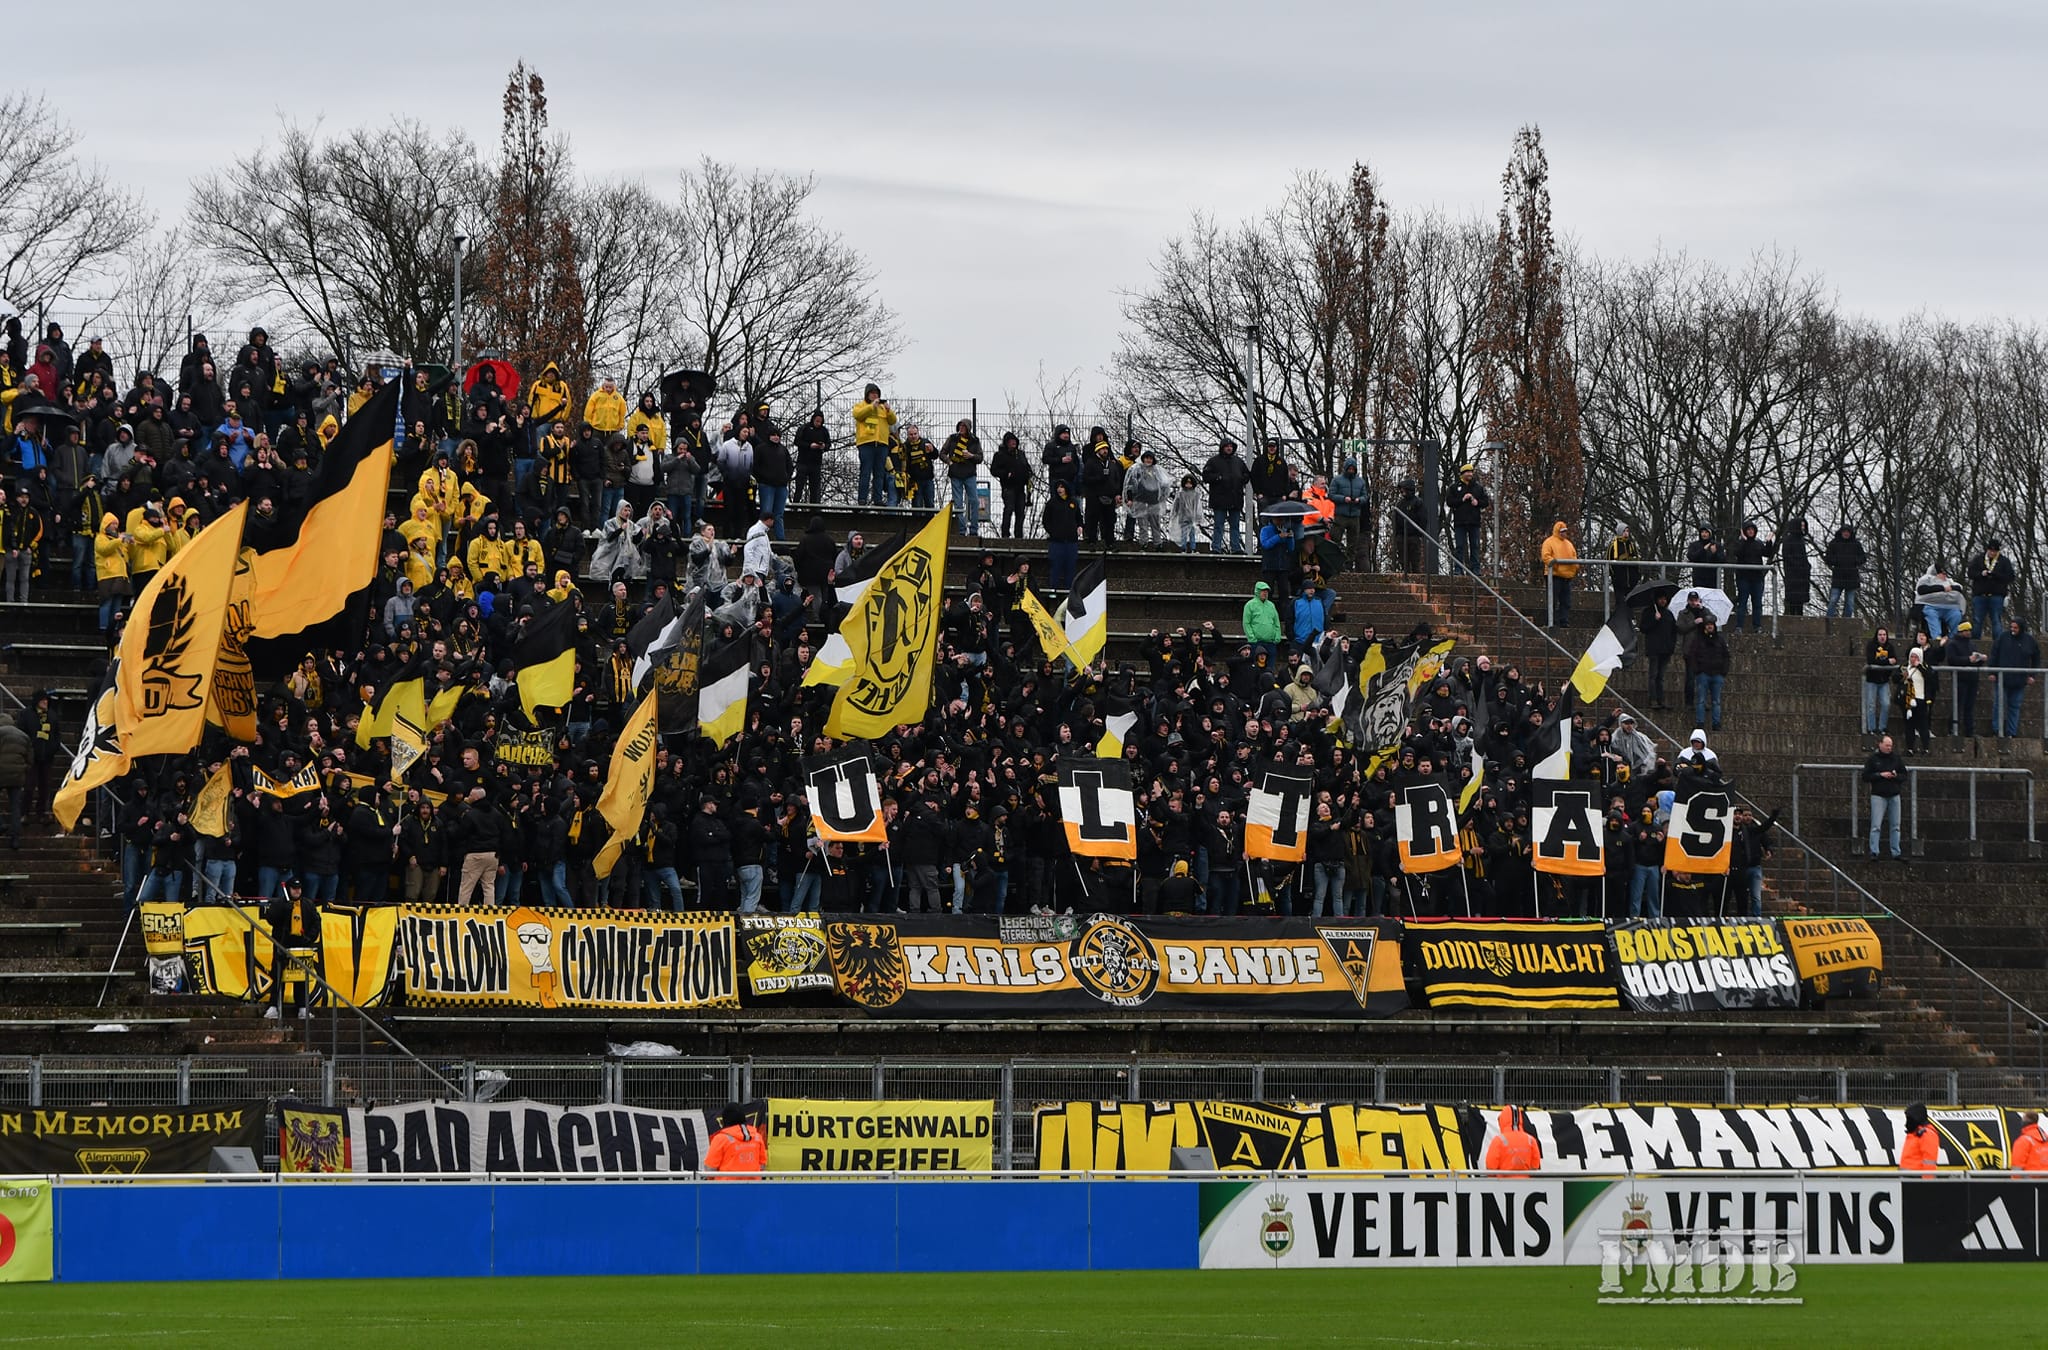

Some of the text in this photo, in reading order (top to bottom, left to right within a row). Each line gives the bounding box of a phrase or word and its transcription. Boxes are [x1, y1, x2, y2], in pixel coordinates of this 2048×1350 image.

[809, 756, 878, 834] U
[1072, 770, 1130, 842] L
[1404, 783, 1458, 857] R
[1538, 791, 1600, 861] A
[1679, 791, 1731, 859] S
[743, 915, 821, 929] FÜR STADT
[1000, 917, 1053, 929] LEGENDEN
[1793, 921, 1868, 939] OECHER
[401, 915, 734, 1003] YELLOW CONNECTION
[1346, 940, 1364, 960] A
[1511, 944, 1605, 974] WACHT
[1615, 924, 1785, 963] BOXSTAFFEL
[1814, 945, 1869, 967] KRAU
[904, 946, 1324, 985] KARLS BANDE
[1621, 954, 1797, 998] HOOLIGANS
[756, 976, 787, 991] UND
[772, 1110, 991, 1139] HÜRTGENWALD
[1203, 1102, 1292, 1134] ALEMANNIA
[1931, 1110, 1997, 1120] ALEMANNIA
[486, 1107, 700, 1181] AACHEN
[1231, 1131, 1263, 1167] A
[1967, 1122, 1995, 1147] A
[85, 1151, 141, 1162] Alemannia
[801, 1147, 967, 1171] RUREIFEL
[1307, 1191, 1552, 1259] VELTINS
[1665, 1191, 1896, 1256] VELTINS
